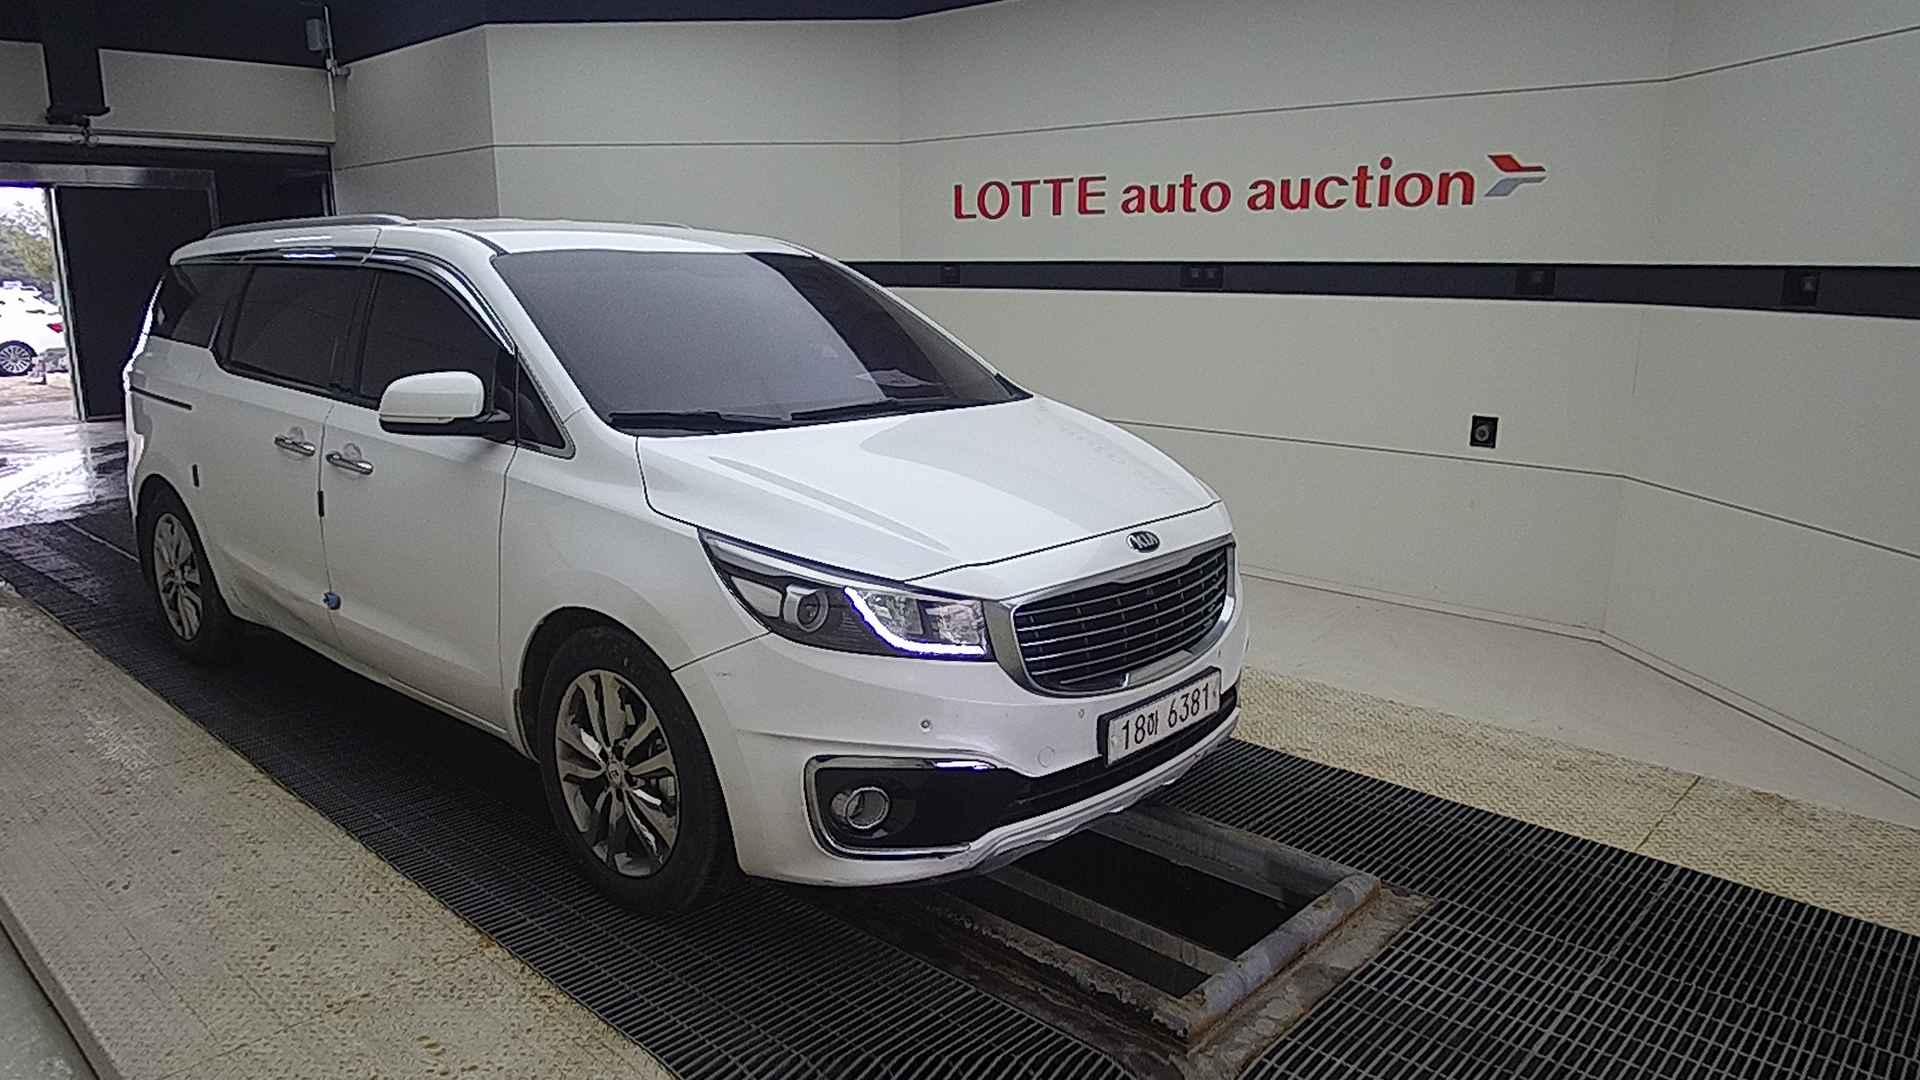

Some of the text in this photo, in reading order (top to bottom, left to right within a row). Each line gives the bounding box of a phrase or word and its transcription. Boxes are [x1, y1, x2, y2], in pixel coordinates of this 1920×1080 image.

[953, 157, 1475, 219] LOTTE auto auction
[1131, 532, 1158, 549] KIA
[1167, 682, 1209, 728] 6381
